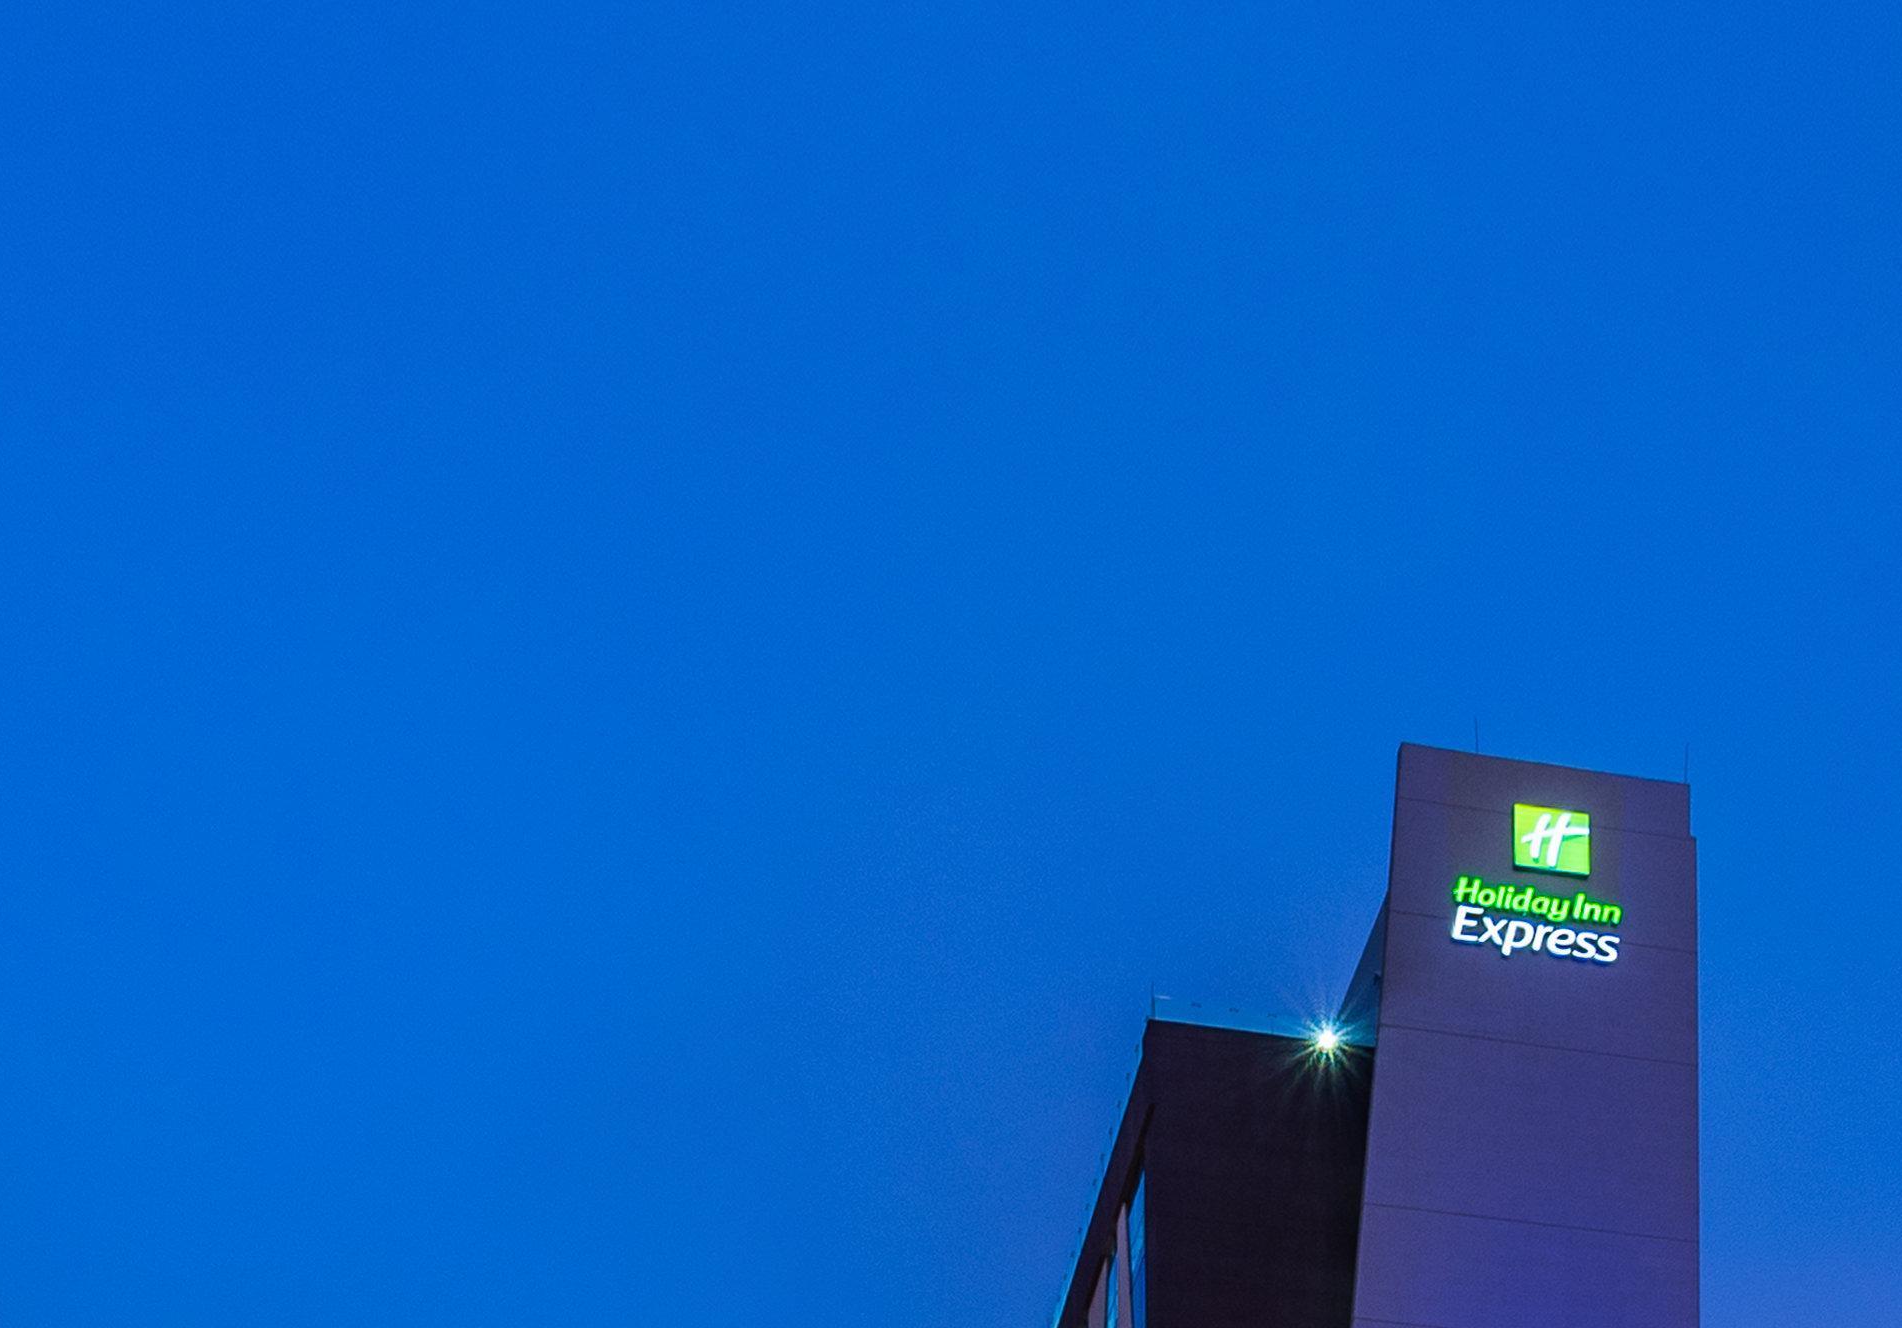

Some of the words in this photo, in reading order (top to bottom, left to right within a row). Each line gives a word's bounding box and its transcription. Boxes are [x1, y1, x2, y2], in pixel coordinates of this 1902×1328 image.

[1454, 876, 1569, 922] Holiday
[1574, 893, 1622, 925] Inn
[1452, 904, 1620, 963] Express
